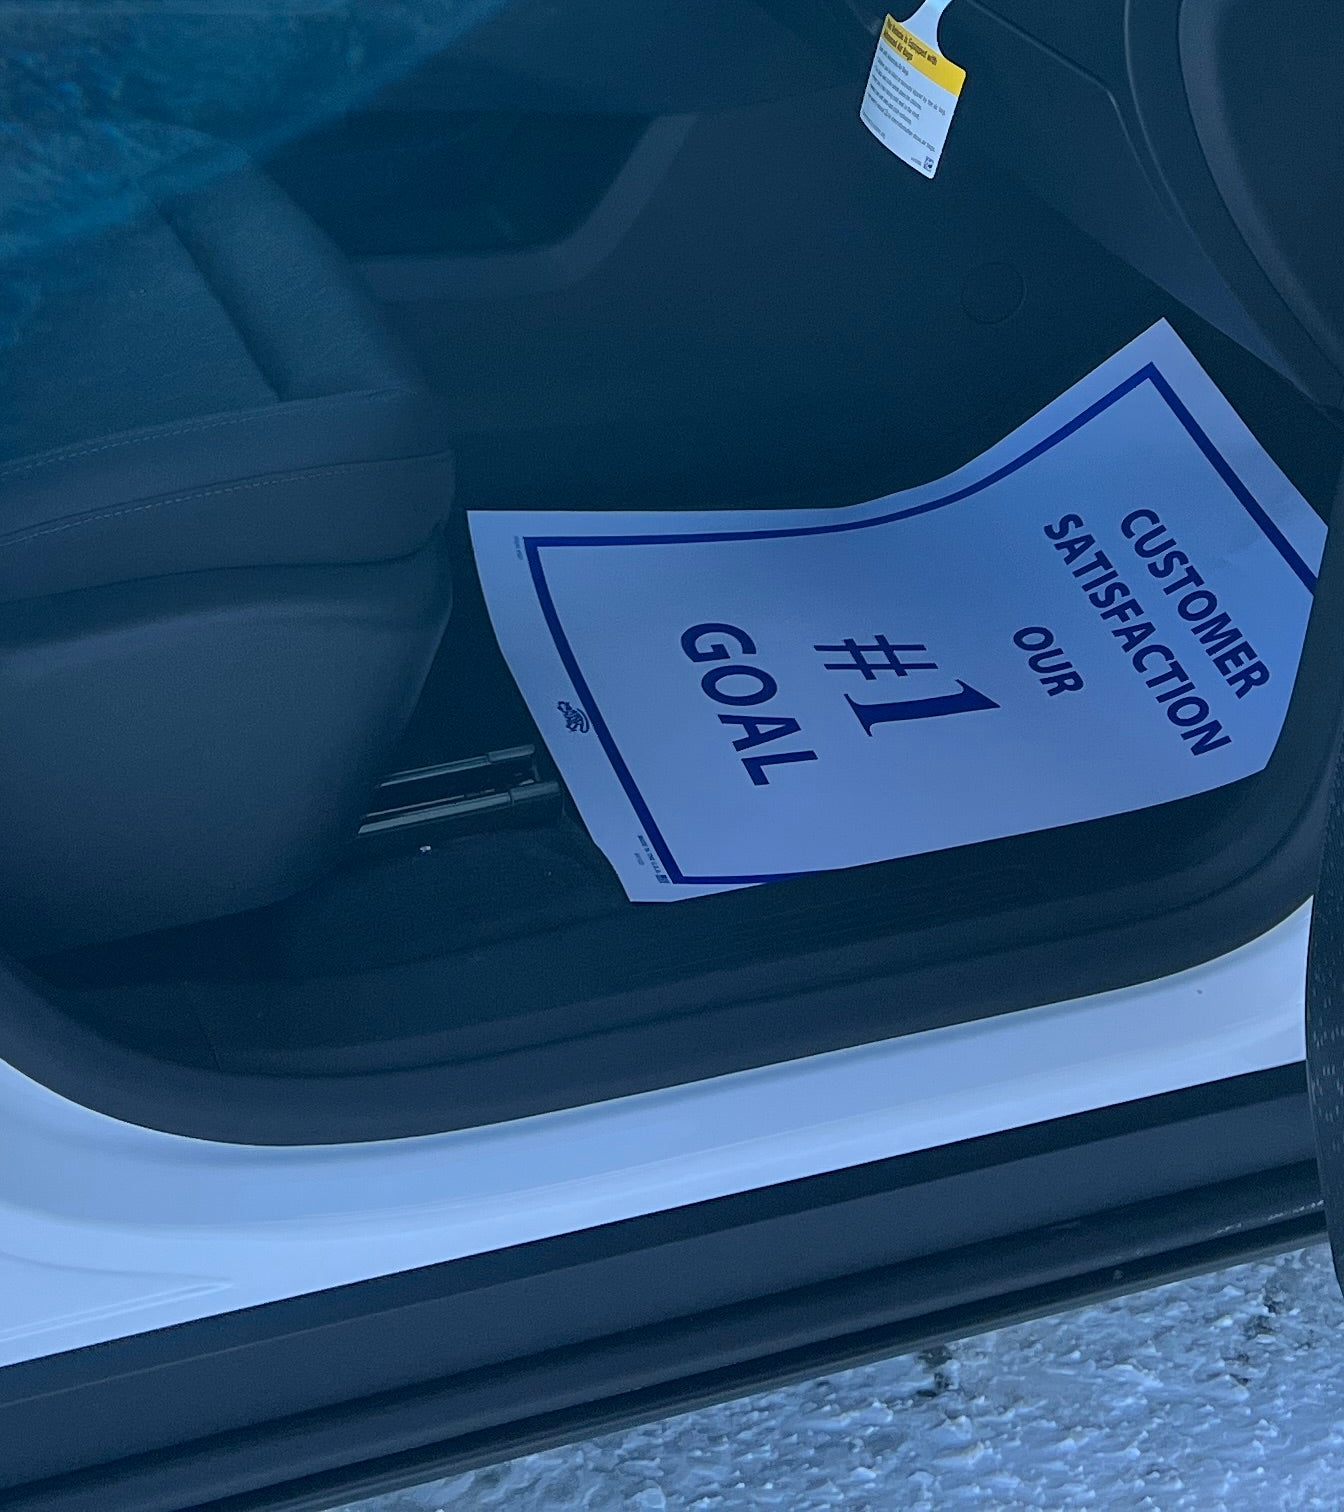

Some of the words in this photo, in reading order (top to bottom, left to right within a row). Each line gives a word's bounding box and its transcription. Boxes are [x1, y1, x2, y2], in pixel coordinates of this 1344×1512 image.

[814, 634, 1001, 737] #1
[1013, 626, 1084, 697] OUR
[1044, 514, 1232, 756] SATISFACTION
[1121, 509, 1269, 699] CUSTOMER
[680, 622, 818, 786] GOAL
